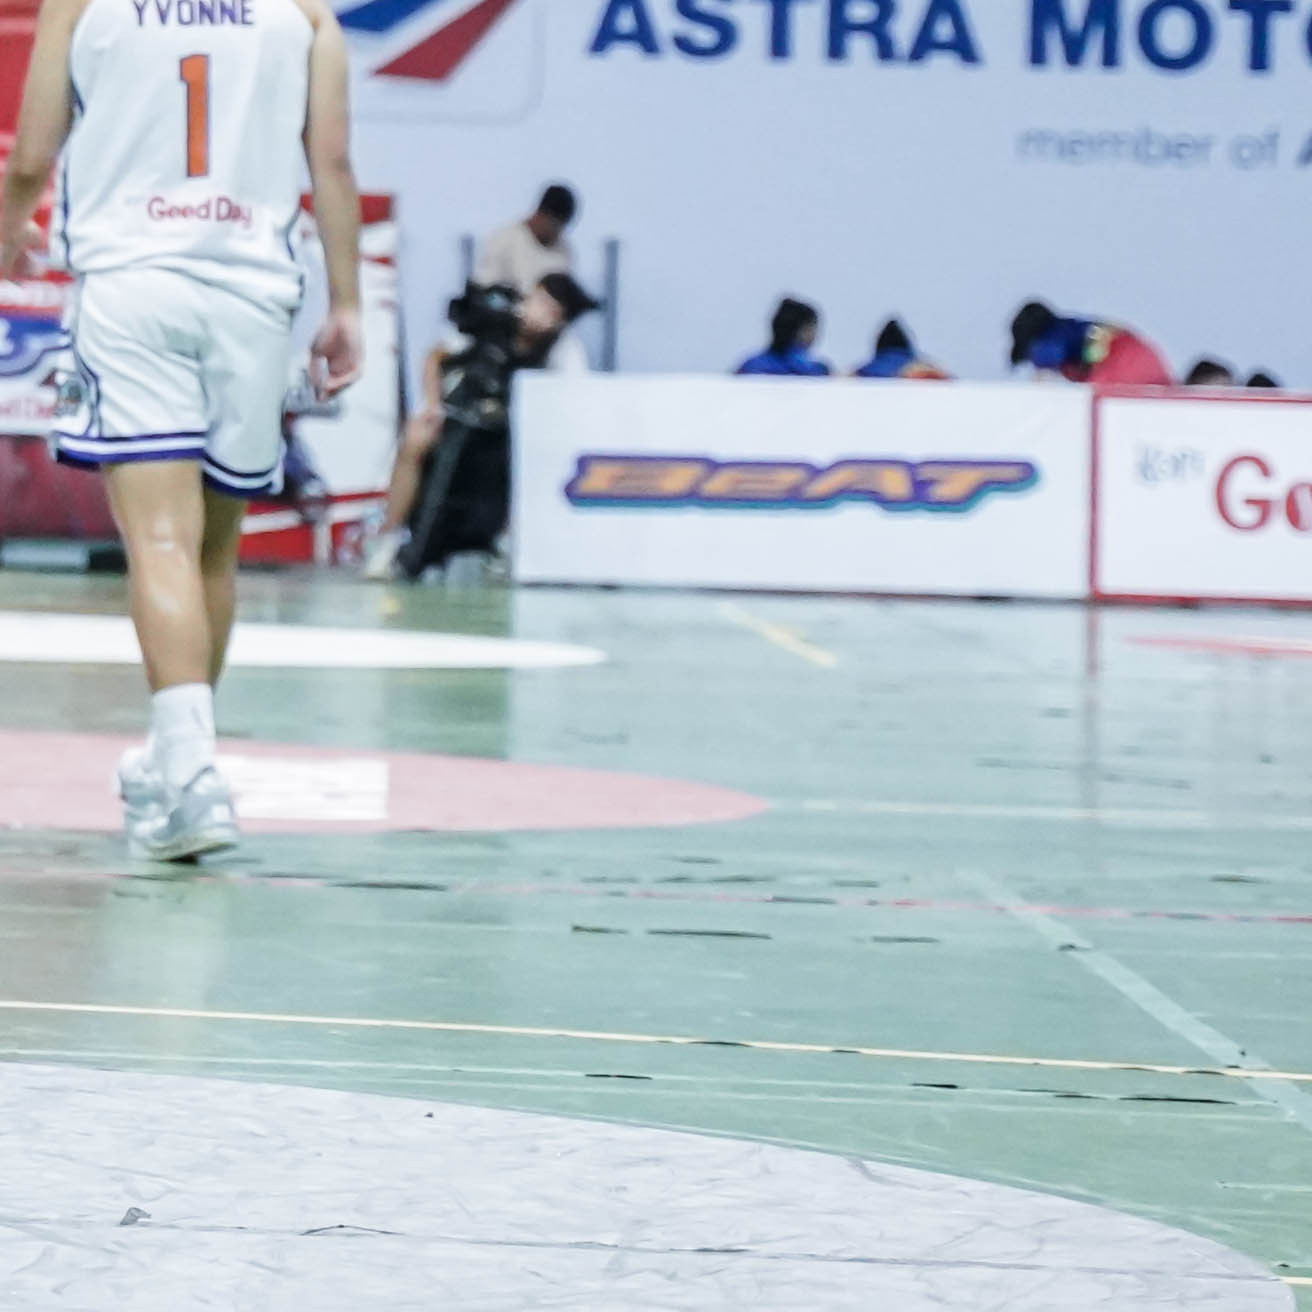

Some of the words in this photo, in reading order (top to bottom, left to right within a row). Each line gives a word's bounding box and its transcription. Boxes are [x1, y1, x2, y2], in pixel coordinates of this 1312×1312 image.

[178, 53, 211, 179] 1
[147, 196, 211, 221] Good
[215, 197, 253, 231] Day
